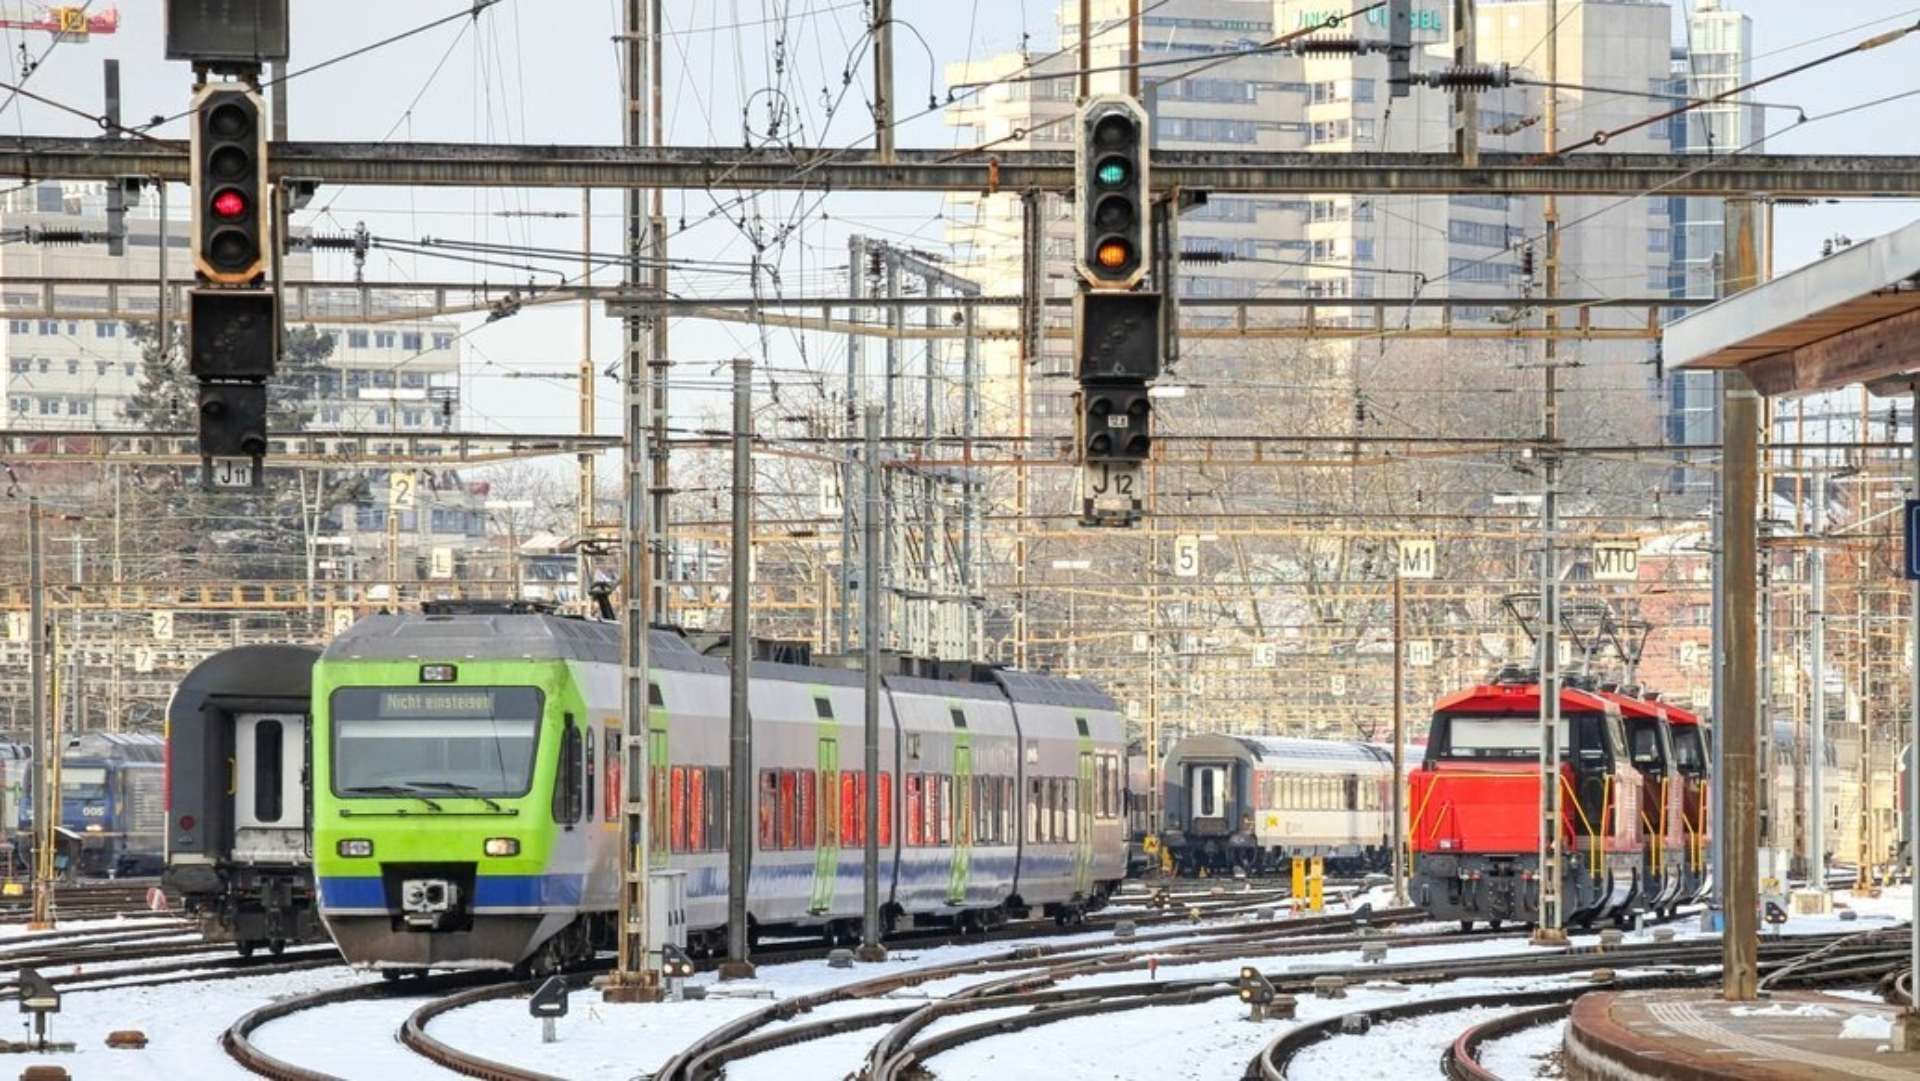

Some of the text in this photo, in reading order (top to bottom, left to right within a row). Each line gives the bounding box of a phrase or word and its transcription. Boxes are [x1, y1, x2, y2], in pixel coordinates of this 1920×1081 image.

[1381, 8, 1442, 30] ISEL
[396, 479, 410, 504] 2
[436, 554, 448, 572] L
[1180, 545, 1193, 570] 5
[1403, 546, 1431, 571] M1
[1595, 549, 1637, 573] M10
[16, 616, 21, 636] 1
[158, 616, 168, 635] 2
[1255, 646, 1275, 664] L6
[1413, 645, 1430, 662] H1
[1684, 645, 1694, 662] 2
[1334, 676, 1343, 692] 5
[387, 694, 421, 709] Nicht
[83, 806, 105, 816] 005
